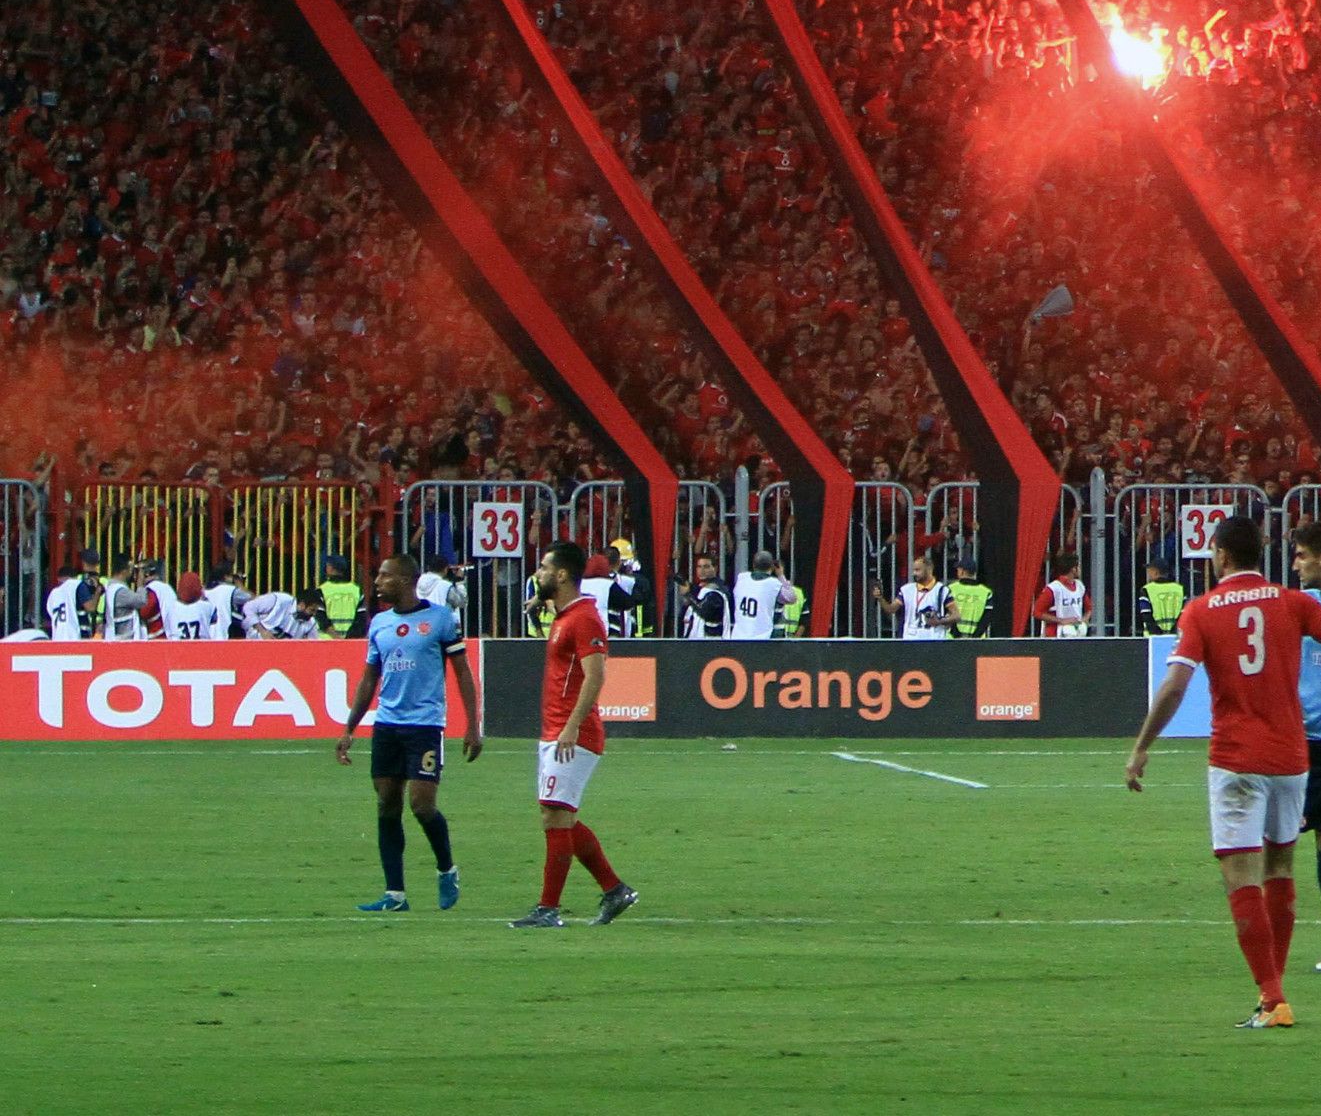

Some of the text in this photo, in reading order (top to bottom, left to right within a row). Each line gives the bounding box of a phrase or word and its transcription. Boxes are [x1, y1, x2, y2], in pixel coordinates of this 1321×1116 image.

[480, 509, 519, 551] 33
[739, 596, 758, 617] 40
[1062, 596, 1082, 607] CAF
[1208, 586, 1280, 609] R.RABIA
[178, 621, 200, 639] 37
[1238, 606, 1266, 675] 3
[12, 655, 378, 728] TOTAL
[700, 657, 933, 721] Orange
[598, 705, 649, 720] orange
[980, 703, 1034, 718] orange
[422, 750, 436, 772] 6
